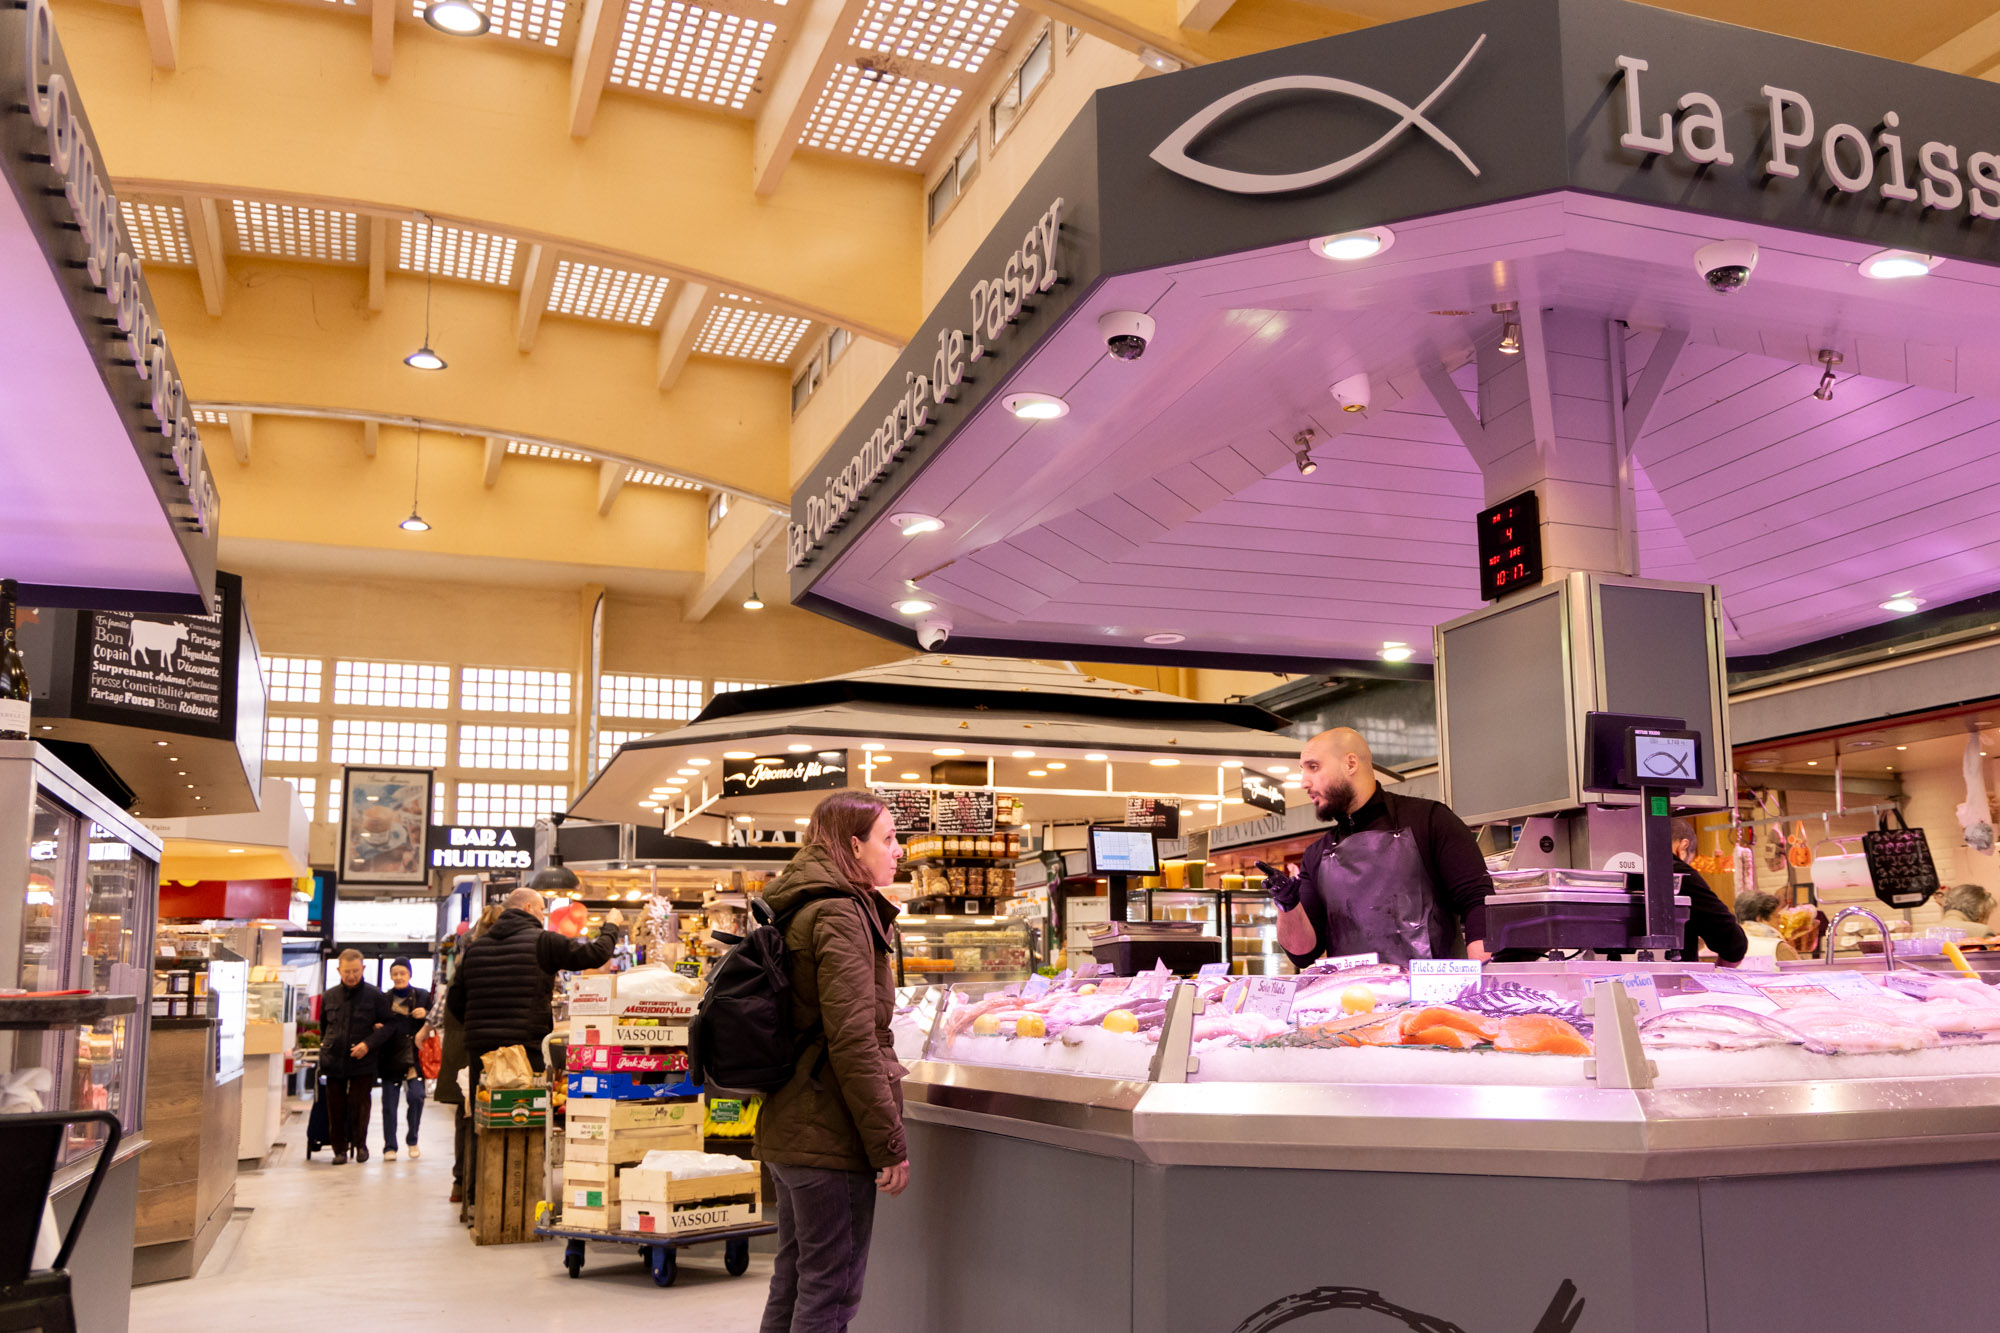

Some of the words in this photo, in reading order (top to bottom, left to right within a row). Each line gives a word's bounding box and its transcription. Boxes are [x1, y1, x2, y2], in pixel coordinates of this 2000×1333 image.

[1616, 55, 1734, 166] La
[1761, 85, 2000, 220] Poiss
[26, 0, 150, 379] Comptoir
[786, 520, 805, 573] La
[806, 372, 929, 551] Poissonnerie
[932, 327, 965, 404] de
[970, 197, 1063, 362] Passy
[1496, 563, 1524, 586] 10:17
[95, 626, 124, 645] Bon
[190, 632, 221, 650] Partage
[93, 643, 129, 662] Copain
[181, 644, 220, 663] Dégustation
[93, 660, 154, 680] Surprenant
[177, 659, 219, 677] Découverte
[122, 679, 183, 699] Convivialité
[91, 687, 124, 704] Partage
[124, 692, 155, 707] Force
[156, 698, 177, 711] Bon
[179, 701, 218, 717] Robuste
[794, 762, 805, 778] &
[803, 761, 823, 782] fils
[451, 828, 496, 846] BAR
[499, 829, 517, 846] A
[1212, 827, 1225, 844] DE
[1227, 826, 1240, 841] LA
[1242, 815, 1287, 839] VIANDE
[1619, 861, 1636, 869] SOUS
[1412, 961, 1435, 973] Filets
[1437, 962, 1447, 973] de
[623, 1005, 692, 1015] MERIDIONALE
[616, 1029, 673, 1041] VASSOUT
[616, 1057, 637, 1069] Pink
[638, 1057, 659, 1069] Lady
[671, 1210, 729, 1228] VASSOUT
